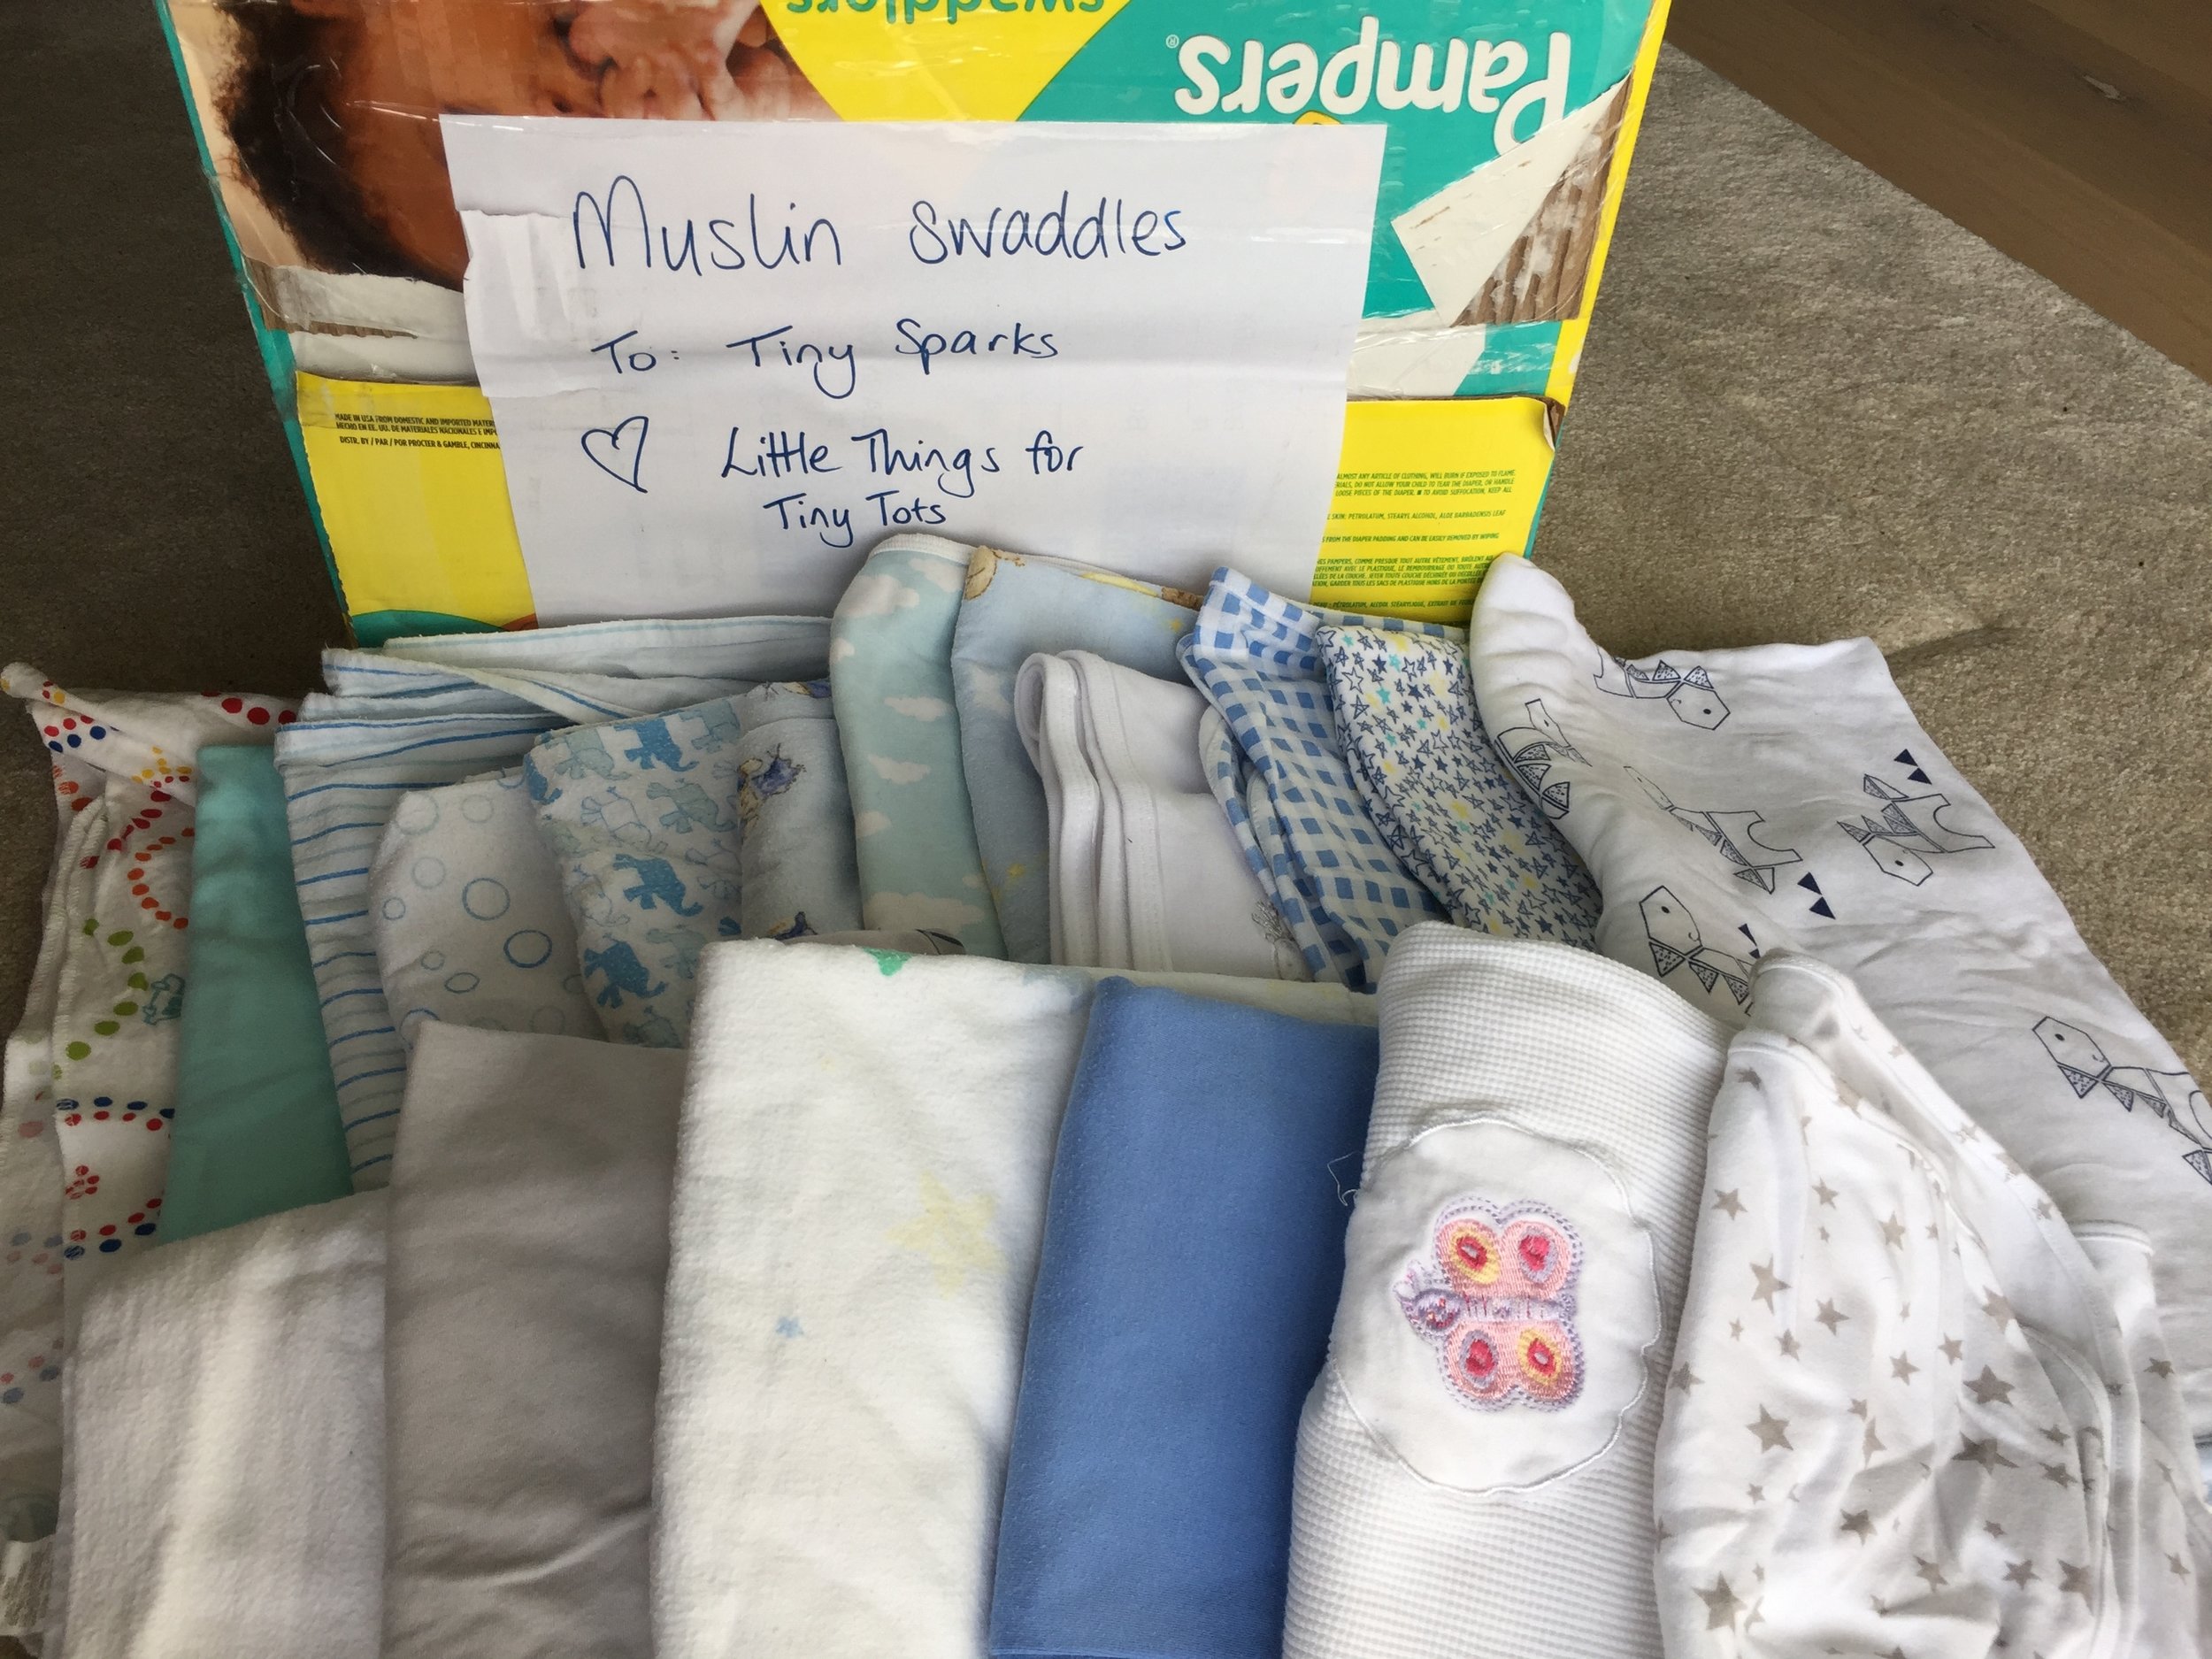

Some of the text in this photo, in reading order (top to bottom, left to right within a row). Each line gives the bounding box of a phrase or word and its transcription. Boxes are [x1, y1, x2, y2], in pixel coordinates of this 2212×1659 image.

[1175, 17, 1571, 157] Pampers
[573, 175, 1187, 276] Muslin Swaddles
[591, 318, 1058, 400] To: Tiny Sparks
[394, 438, 408, 447] POR
[440, 418, 471, 426] IMPORTED
[721, 426, 1084, 497] Little Things for
[762, 489, 947, 548] Tiny Tots
